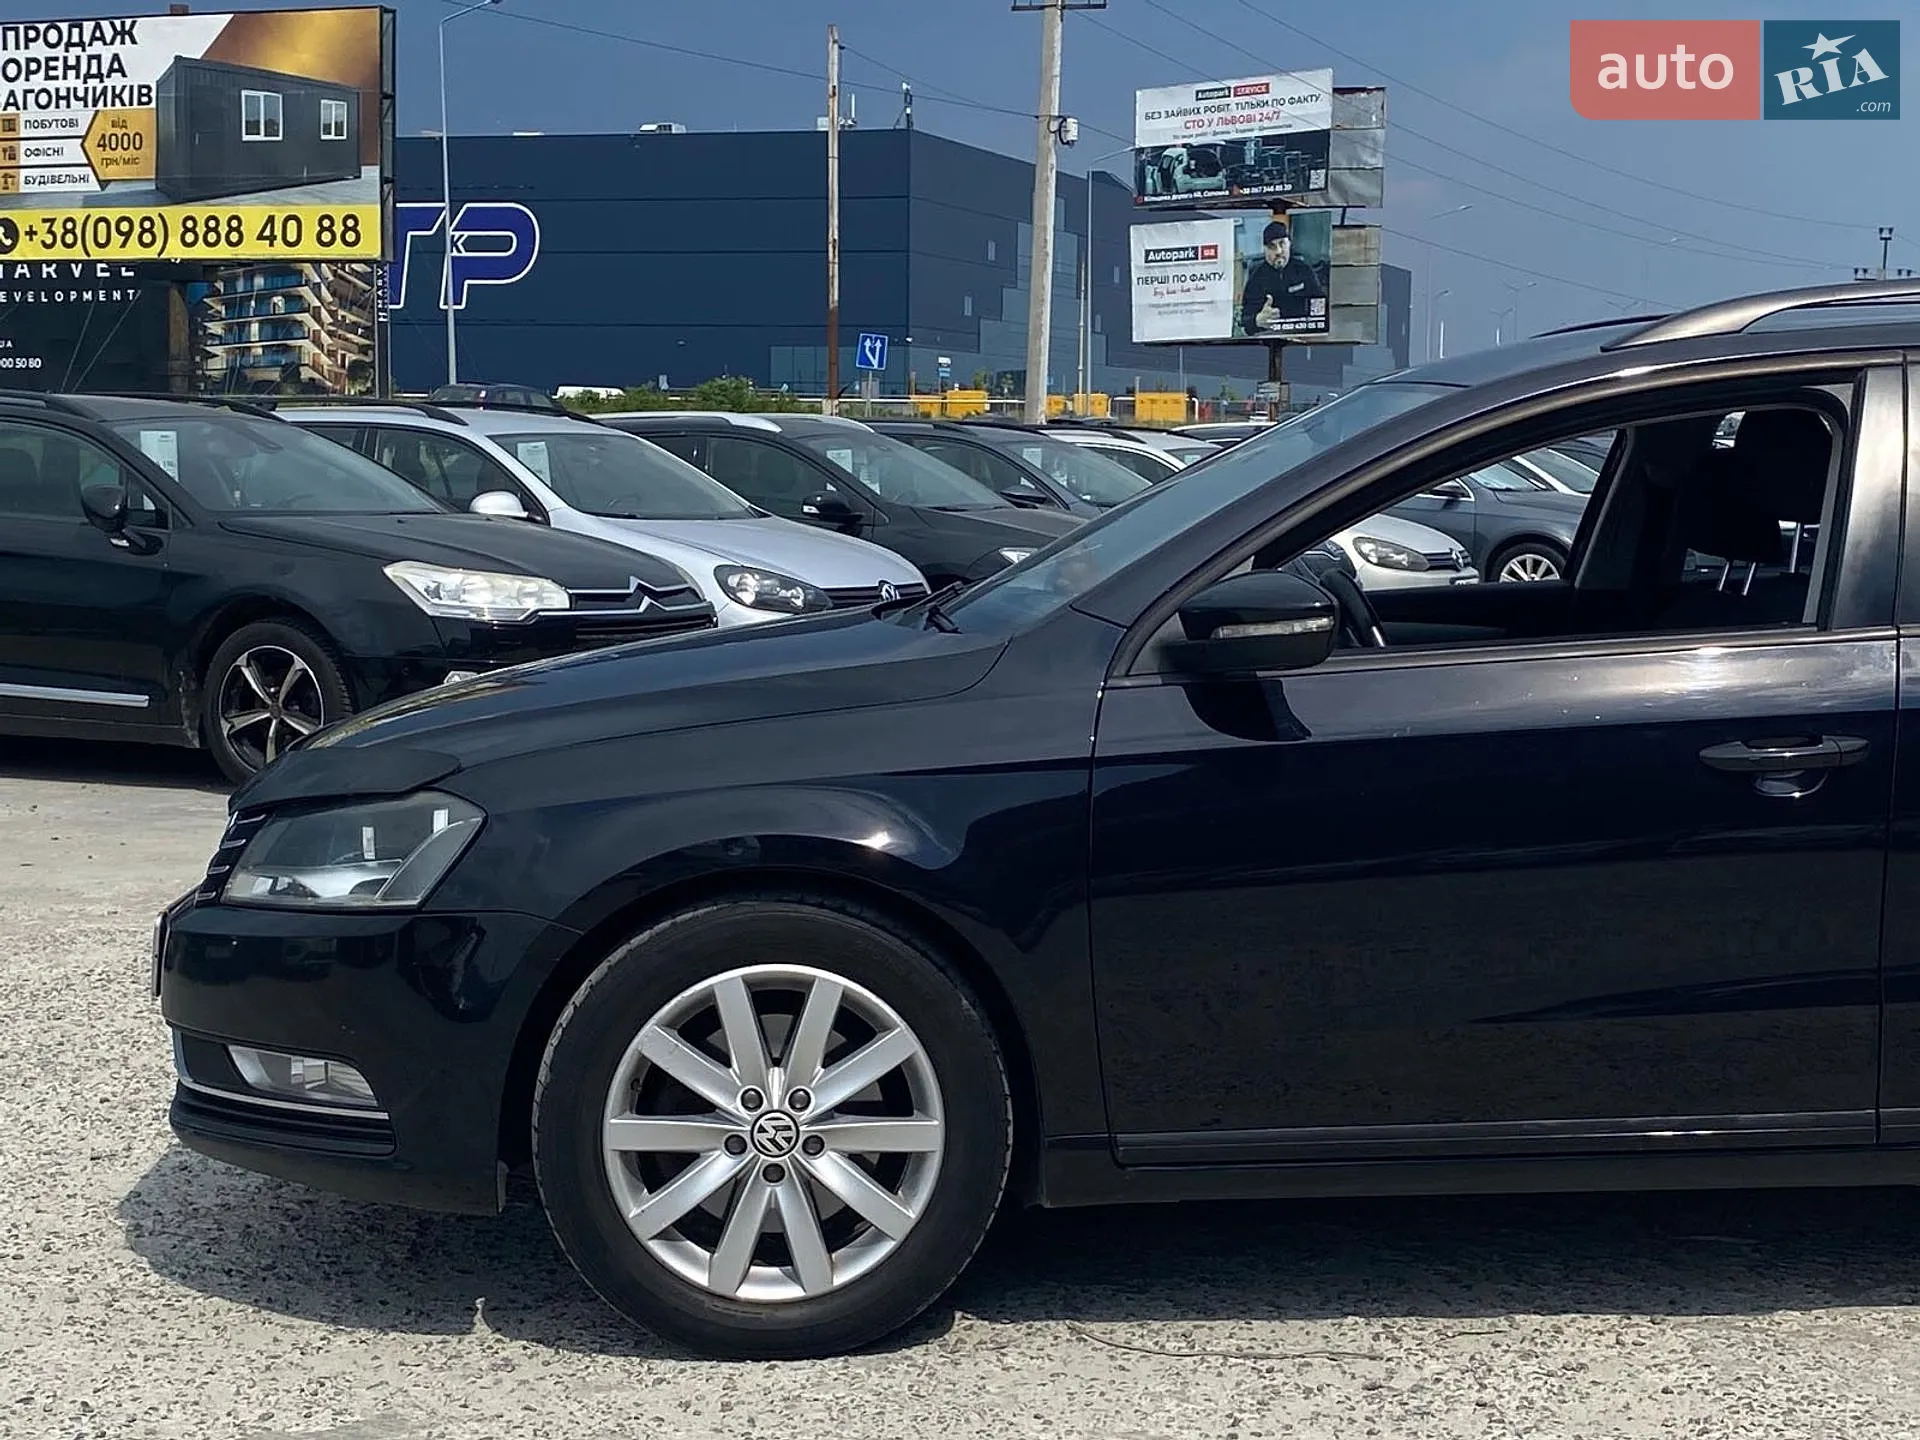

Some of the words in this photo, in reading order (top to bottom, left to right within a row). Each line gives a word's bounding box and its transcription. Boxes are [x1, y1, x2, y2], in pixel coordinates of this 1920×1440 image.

[2, 20, 138, 52] ПРОДАЖ
[2, 53, 128, 84] ОРЕНДА
[2, 84, 154, 111] АГОНЧИКІВ
[1145, 111, 1162, 121] БЕЗ
[1164, 106, 1202, 119] ЗАЙВИХ
[1271, 98, 1286, 107] ПО
[24, 118, 79, 130] ПОБУТОВІ
[111, 118, 128, 129] від
[1184, 119, 1205, 130] СТО
[1207, 118, 1214, 128] У
[1216, 113, 1256, 126] ЛЬВОВІ
[97, 132, 143, 152] 4000
[24, 147, 64, 158] ОФІСНІ
[100, 156, 141, 169] грн/міс
[24, 174, 89, 189] БУДІВЕЛЬНІ
[25, 212, 169, 257] +38(098)
[180, 214, 244, 249] 888
[256, 214, 302, 248] 40
[315, 213, 361, 248] 88
[1148, 247, 1196, 261] Autopark
[1136, 275, 1170, 286] ПЕРШІ
[1172, 274, 1187, 283] ПО
